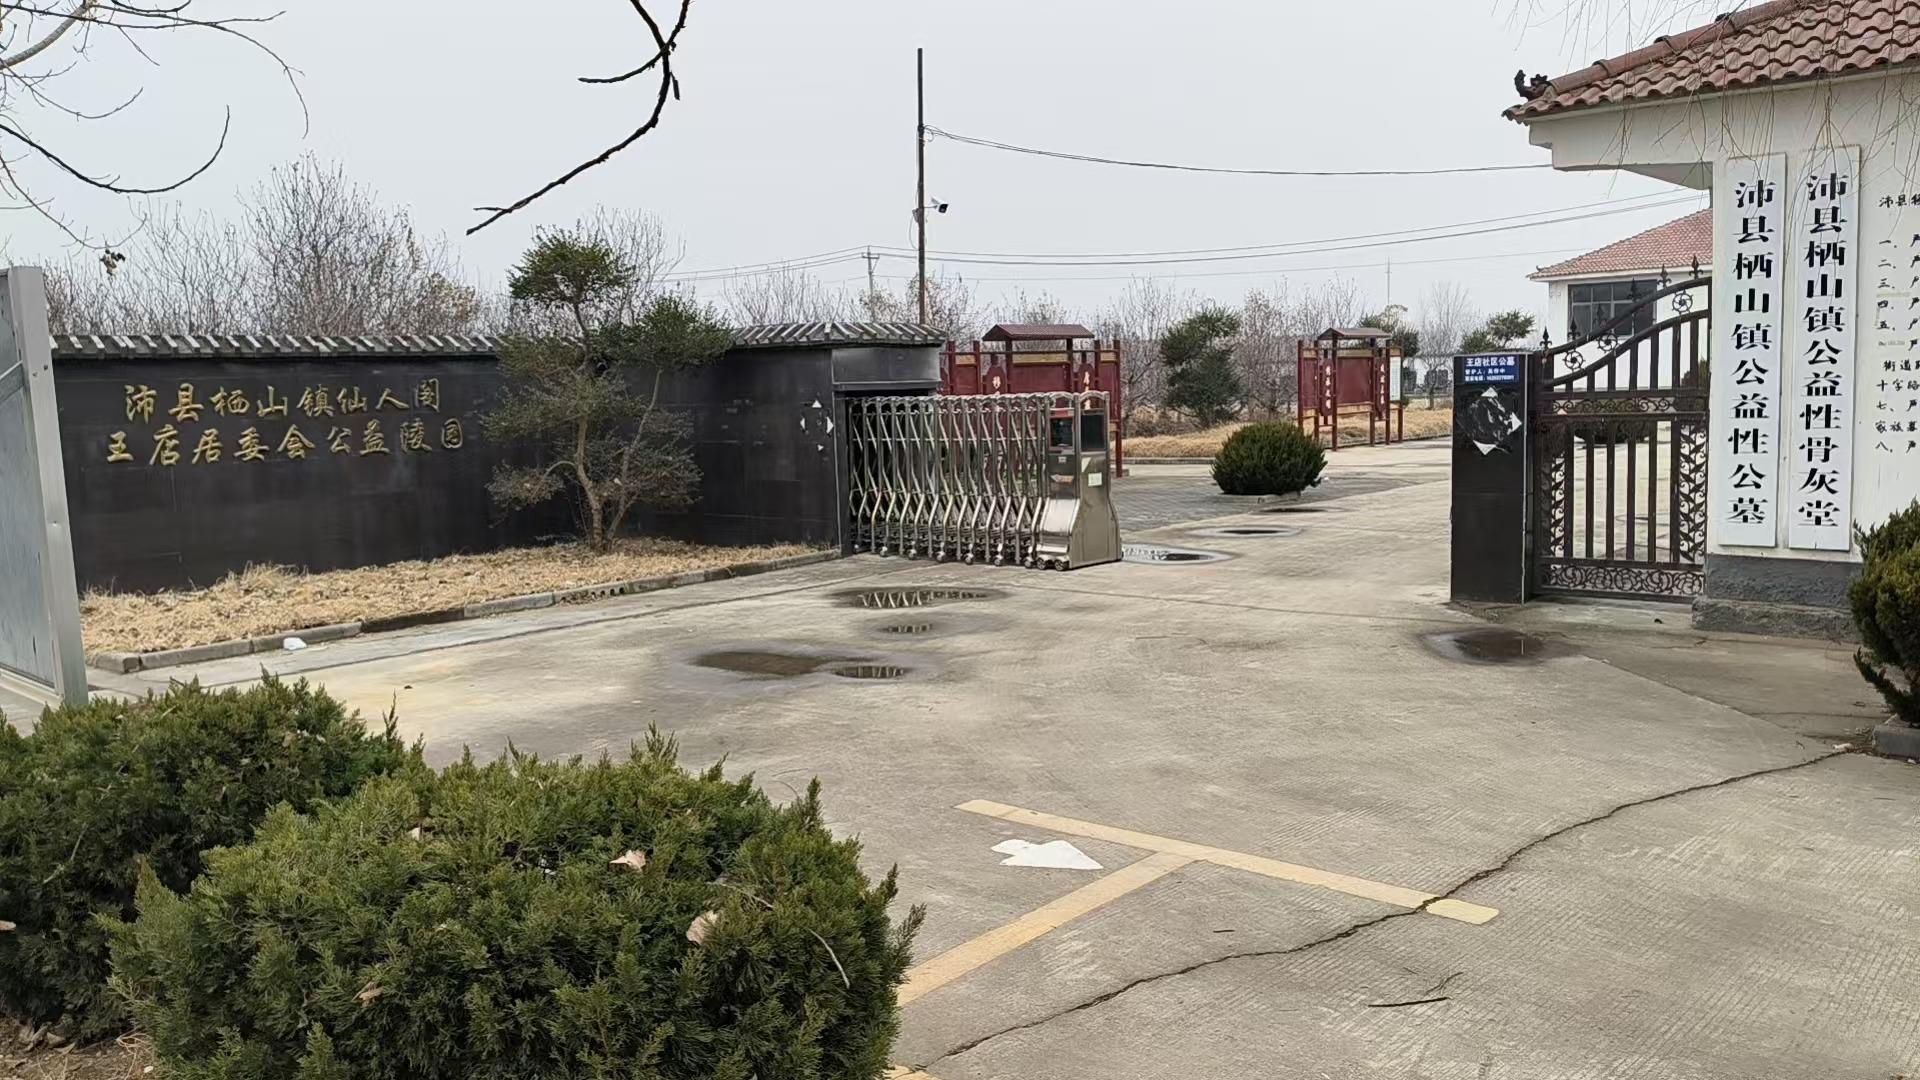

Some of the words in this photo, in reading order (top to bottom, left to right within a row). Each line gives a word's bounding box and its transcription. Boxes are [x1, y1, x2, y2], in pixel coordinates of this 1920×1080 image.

[106, 418, 463, 466] 王店居委会公益陵园
[1727, 179, 1776, 525] 沛县栖山镇公益性公墓
[1798, 173, 1849, 527] 沛县栖山镇公益性骨灰堂
